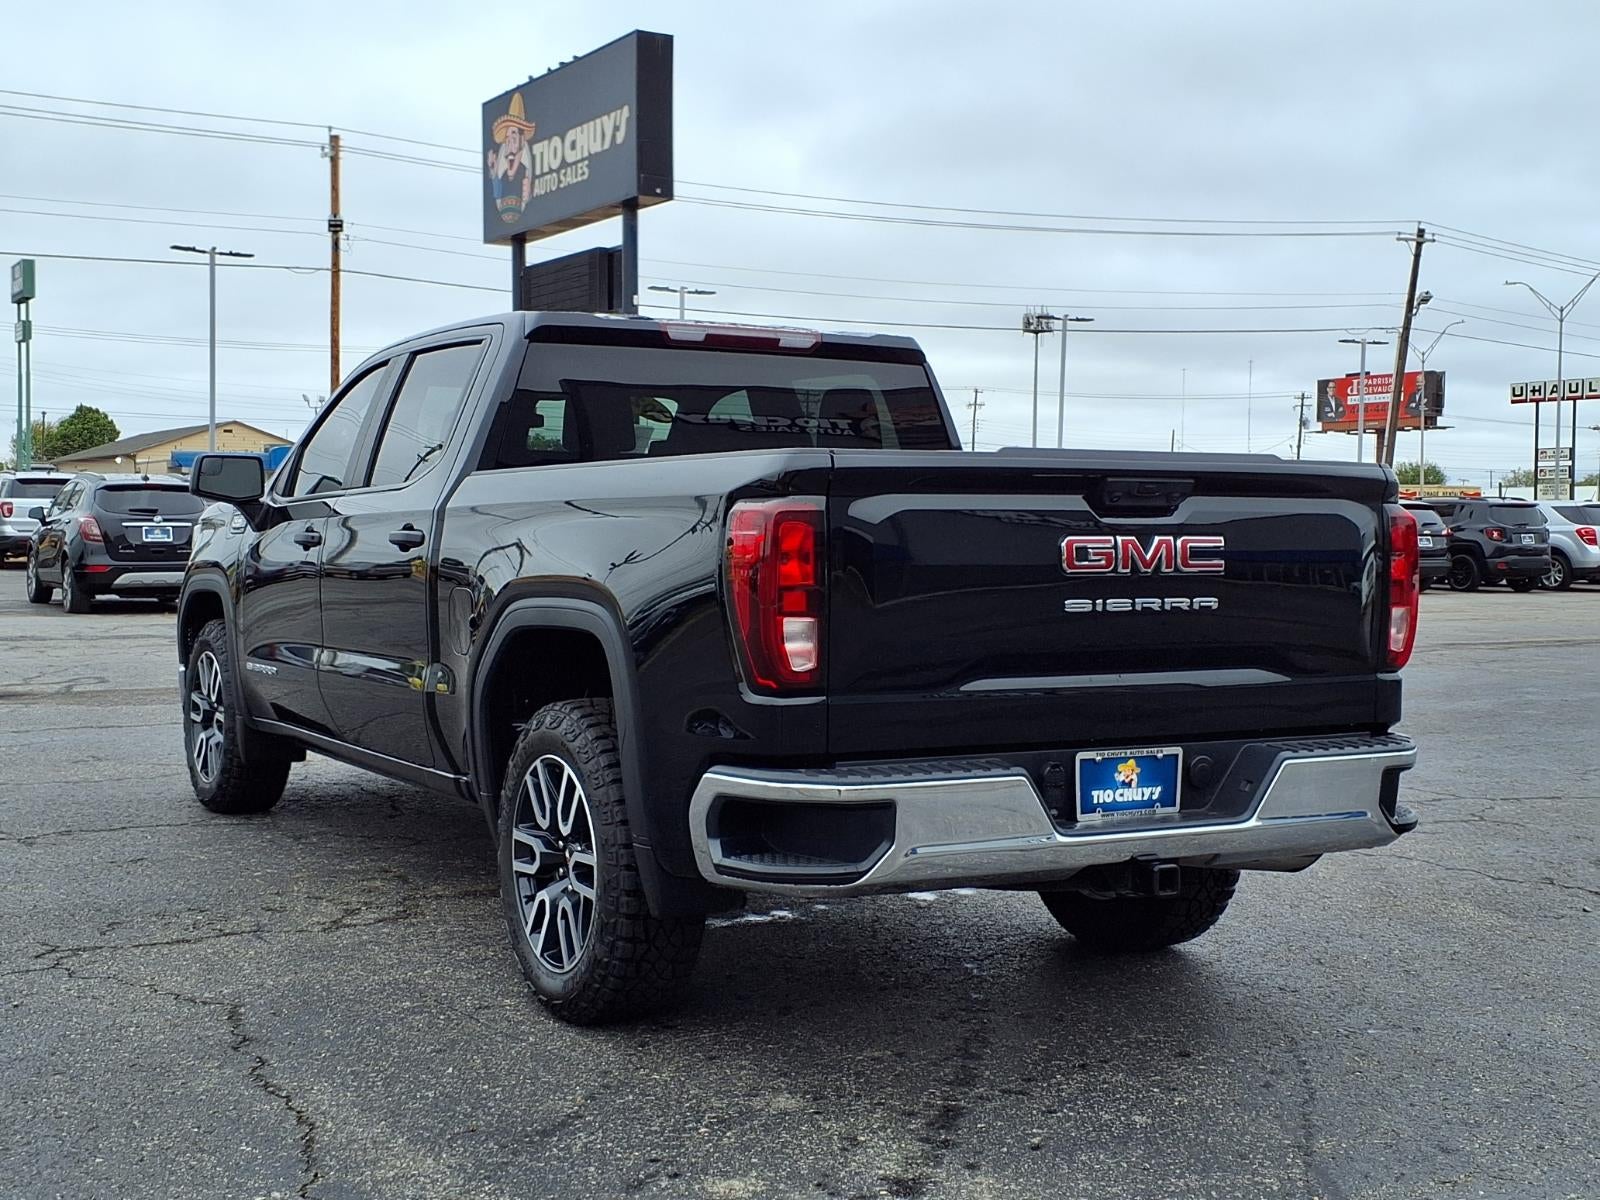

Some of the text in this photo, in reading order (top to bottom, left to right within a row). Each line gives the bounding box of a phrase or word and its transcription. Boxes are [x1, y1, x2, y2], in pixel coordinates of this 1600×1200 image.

[532, 104, 630, 176] TIO CHUY'S
[533, 160, 589, 198] AUTO SALES
[1363, 385, 1403, 394] DEVAUG
[1364, 377, 1393, 386] PARRISH
[1512, 381, 1597, 397] UHAUL
[1061, 535, 1225, 574] GMC
[1064, 597, 1219, 612] SIERRA
[1091, 786, 1162, 804] TIO CHUY'S
